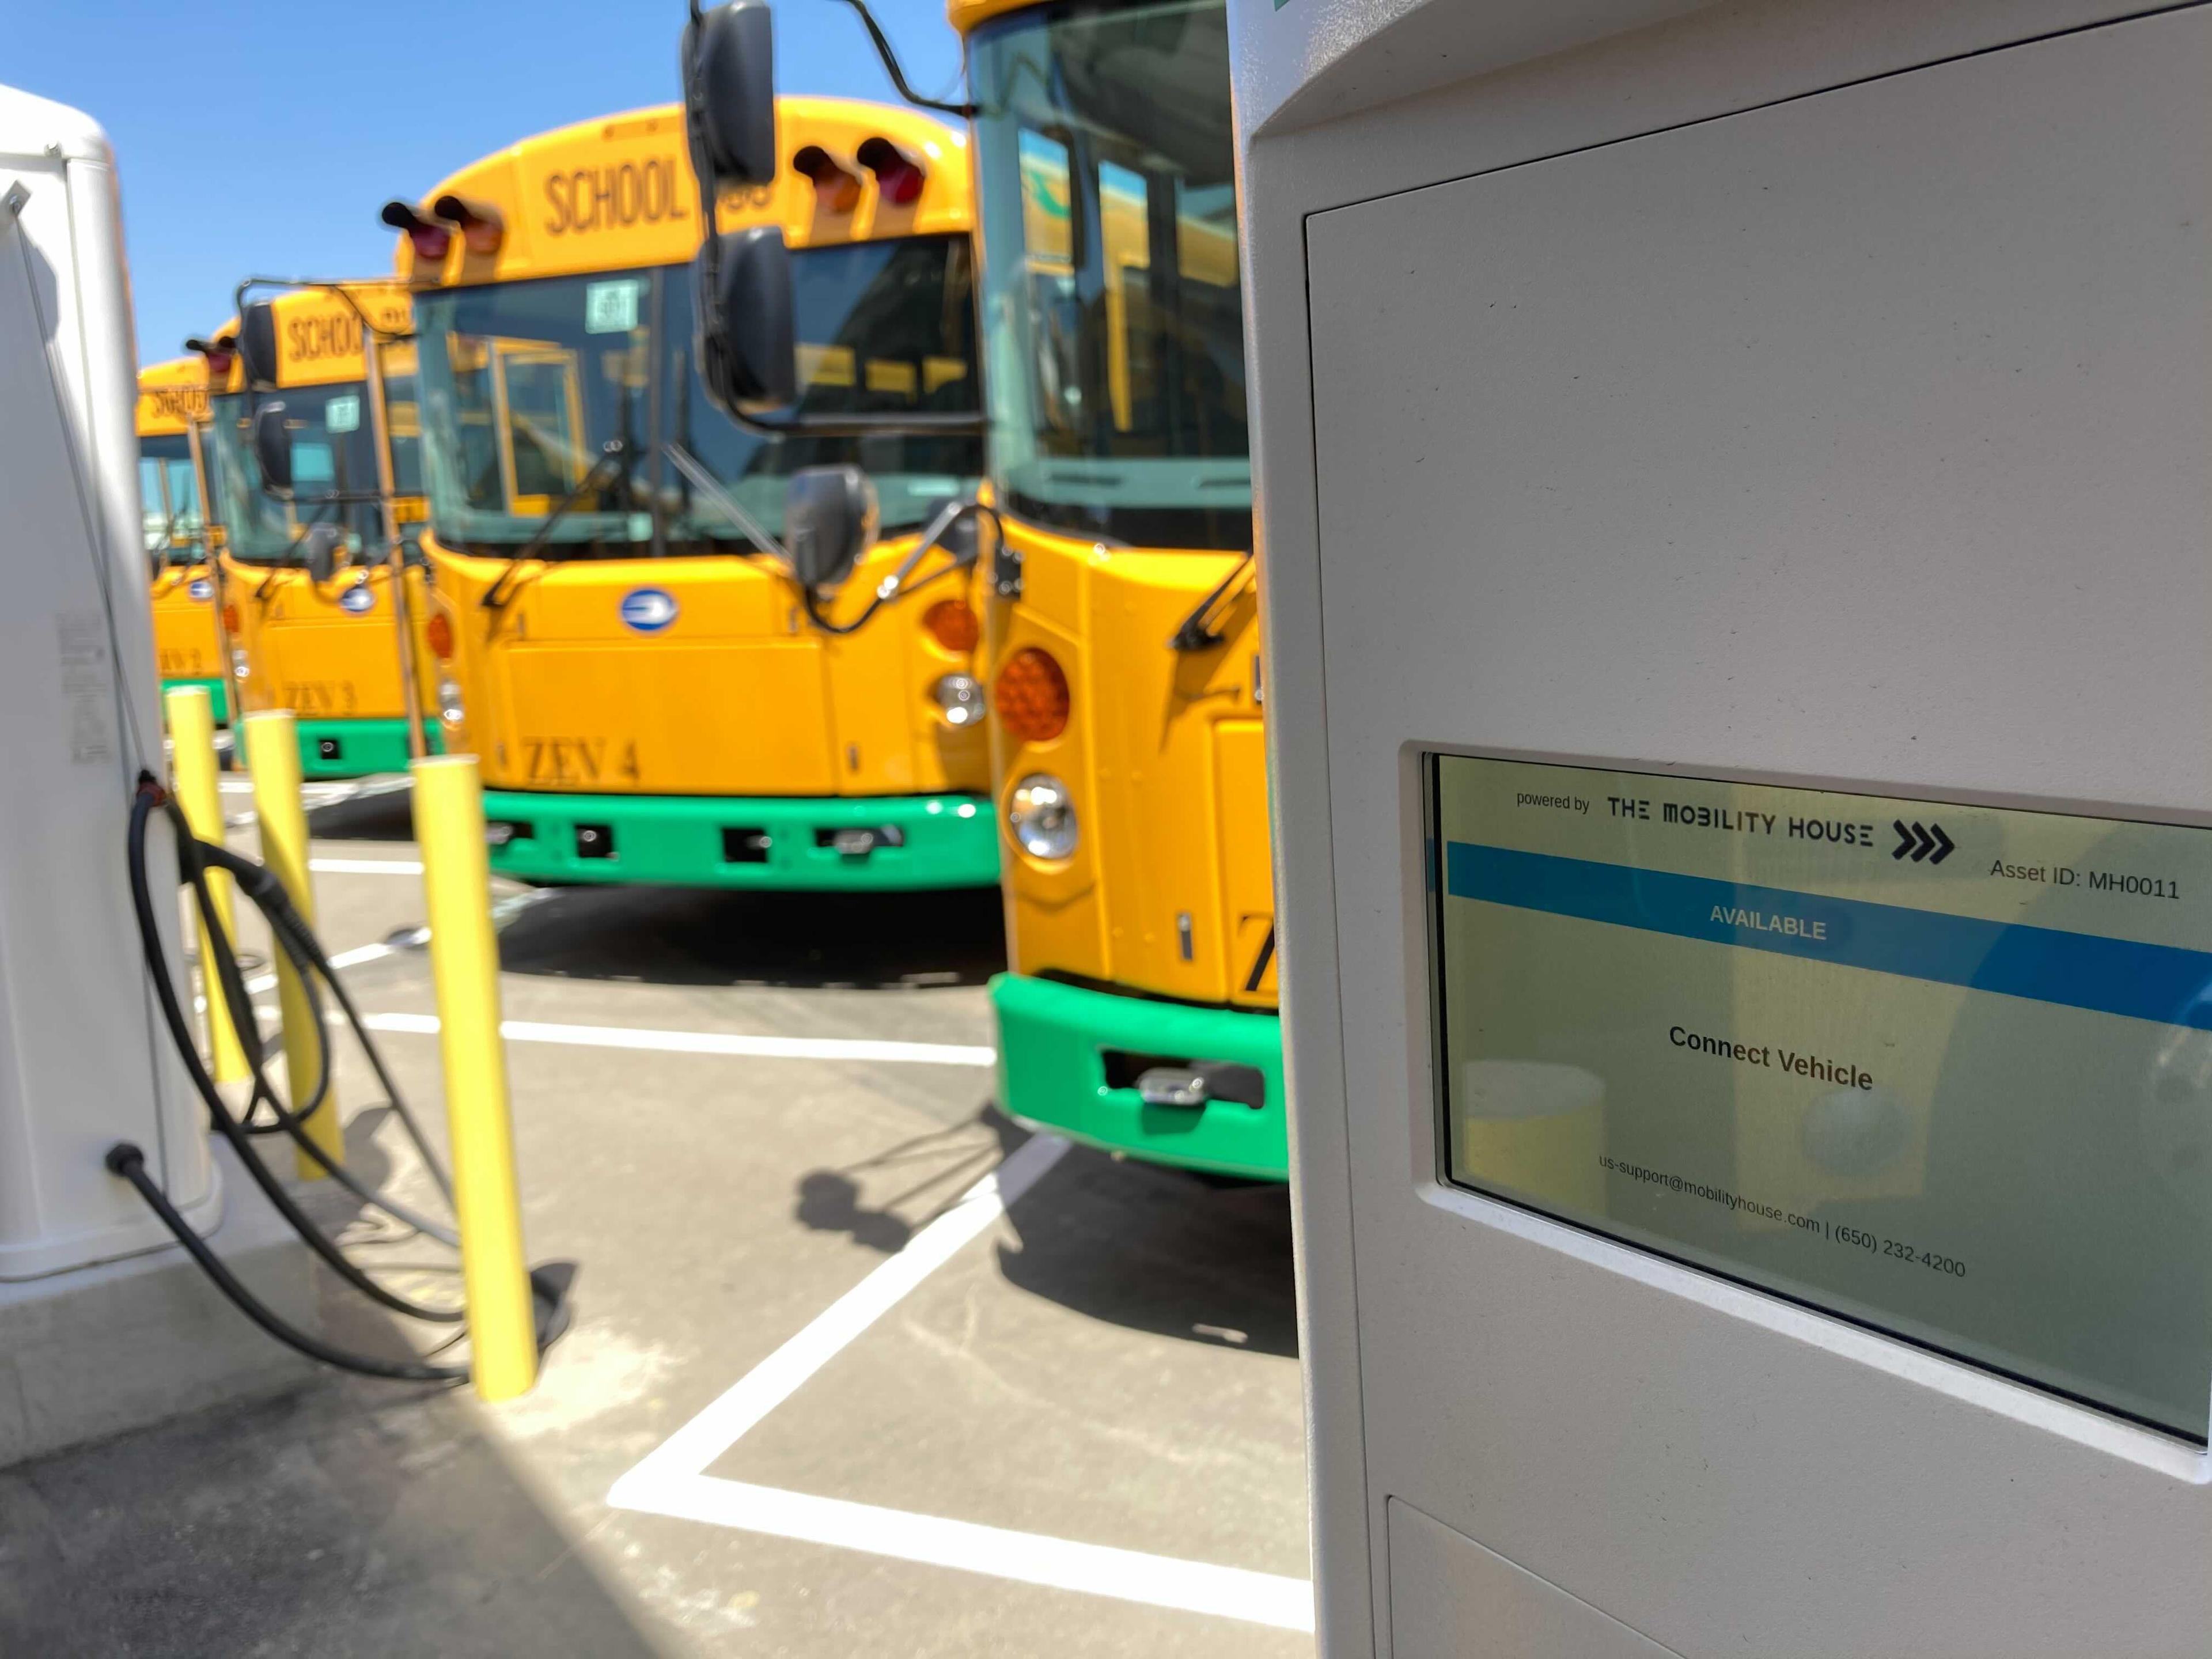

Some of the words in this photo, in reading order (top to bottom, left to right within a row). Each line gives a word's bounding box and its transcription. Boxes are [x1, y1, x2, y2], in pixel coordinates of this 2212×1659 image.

[545, 158, 689, 235] SCHOOL
[289, 312, 365, 362] SCHOO
[618, 736, 641, 787] 4
[1517, 792, 1570, 809] powered
[1574, 796, 1590, 815] by
[1607, 797, 1650, 820] THE
[1663, 803, 1776, 835] MOBILITY
[1789, 817, 1873, 847] HOUSE
[1990, 859, 2046, 882] Asset
[2053, 867, 2081, 887] ID:
[2089, 871, 2180, 899] MH0011
[1710, 905, 1827, 940] AVAILABLE
[1238, 910, 1278, 998] Z
[1669, 1026, 1770, 1067] Connect
[1778, 1049, 1873, 1091] Vehicle
[1599, 1155, 1820, 1234] us-support@mobilityhouse.com
[1835, 1225, 1877, 1253] (650)
[1884, 1240, 1965, 1277] 232-4200
